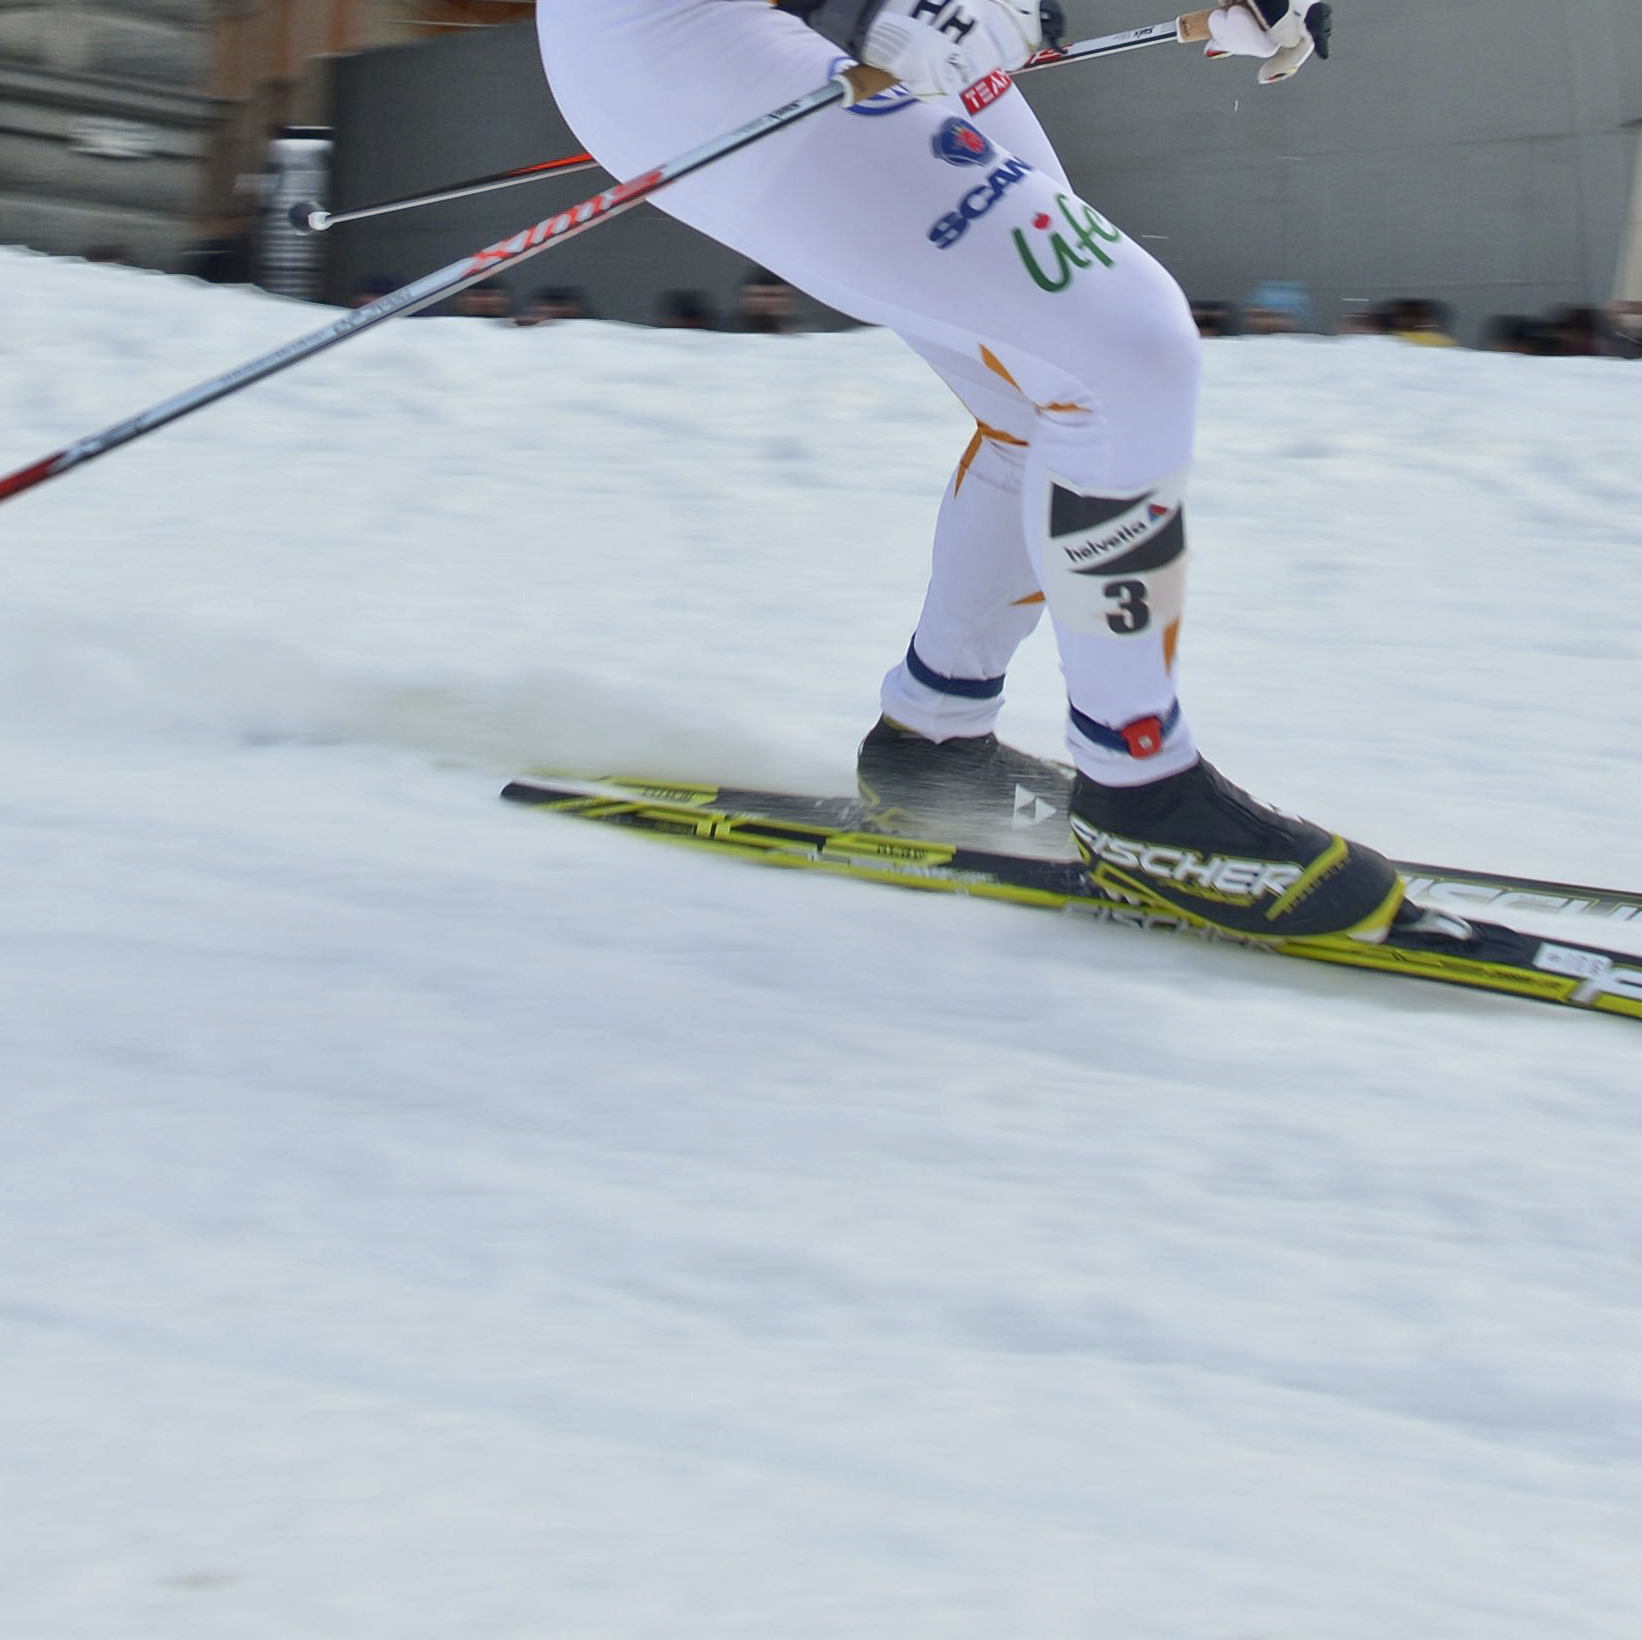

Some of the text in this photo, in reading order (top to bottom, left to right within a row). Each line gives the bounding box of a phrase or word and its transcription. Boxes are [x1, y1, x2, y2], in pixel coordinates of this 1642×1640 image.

[1063, 521, 1148, 563] helvetia
[1103, 578, 1150, 635] 3
[1069, 813, 1309, 899] FISCHER
